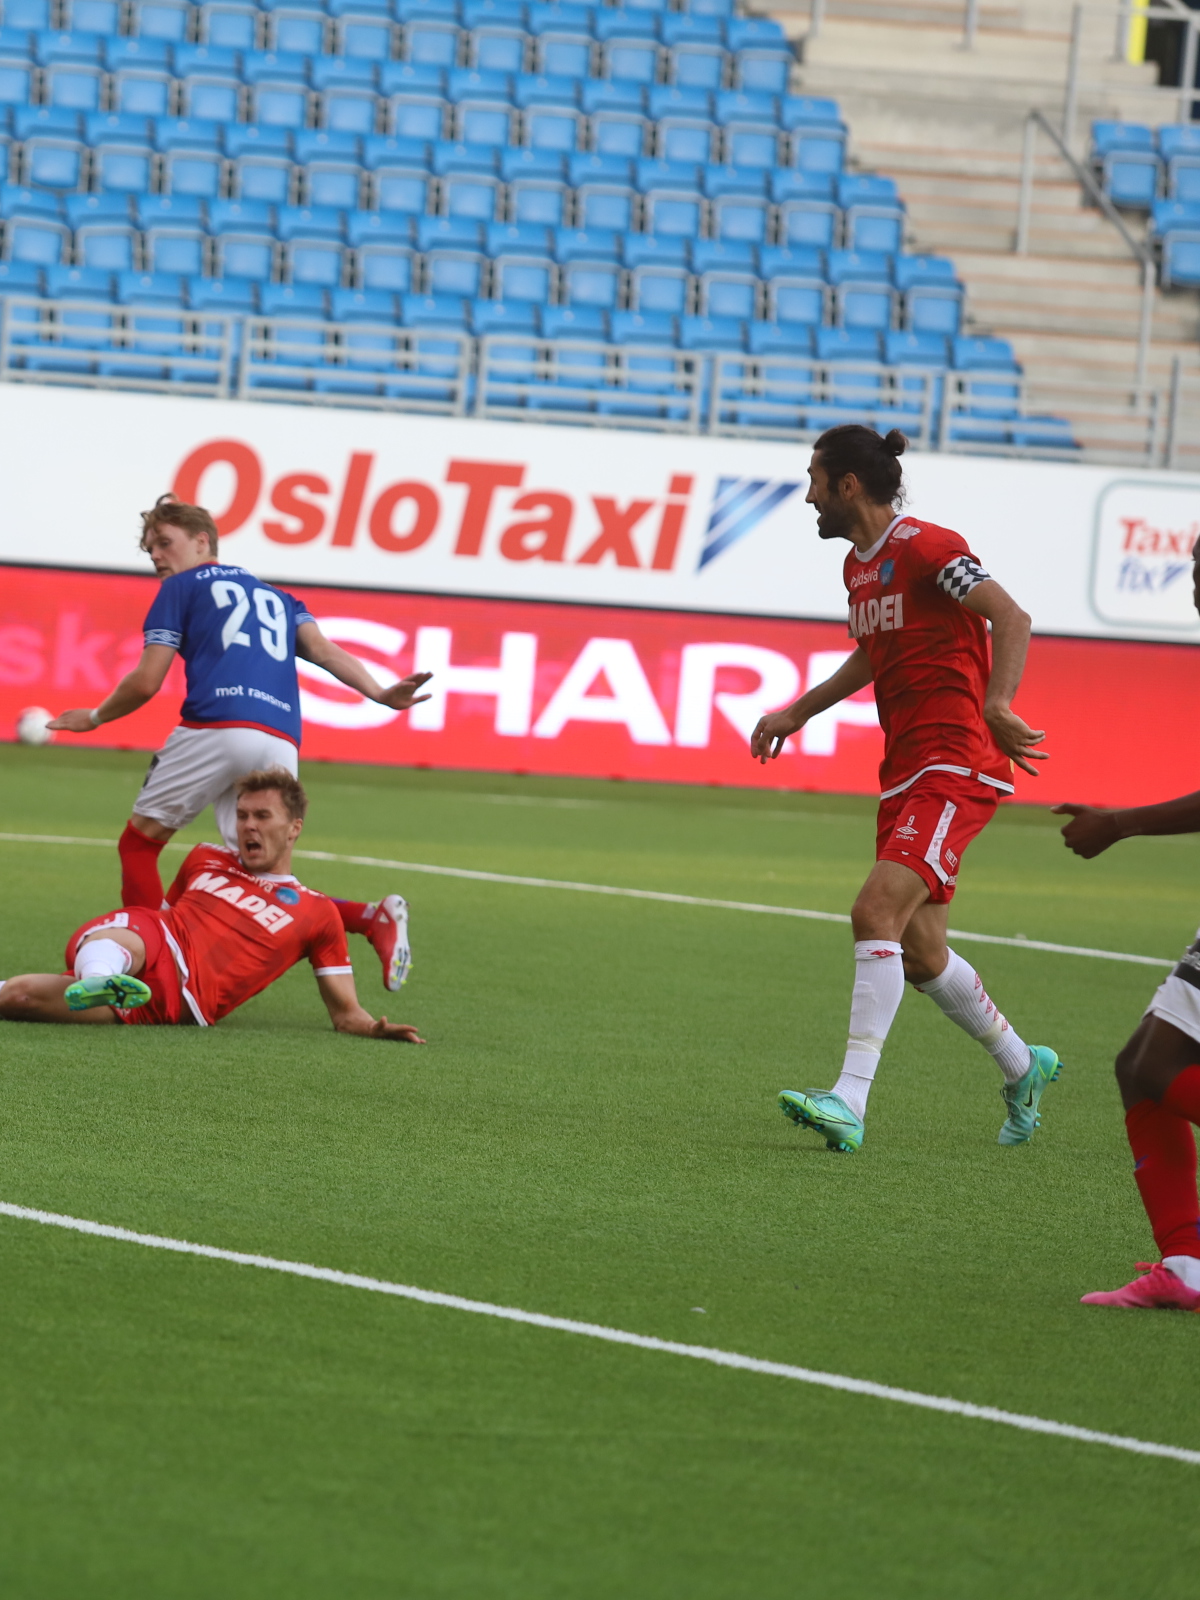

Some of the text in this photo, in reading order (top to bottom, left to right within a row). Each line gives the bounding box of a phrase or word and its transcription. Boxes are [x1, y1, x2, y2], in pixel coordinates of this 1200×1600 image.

[172, 437, 695, 572] OsloTaxi
[1118, 517, 1200, 555] Taxi
[210, 579, 288, 662] 29
[215, 684, 292, 713] mot rasisme
[906, 814, 916, 827] 9
[188, 872, 295, 935] MAPEI
